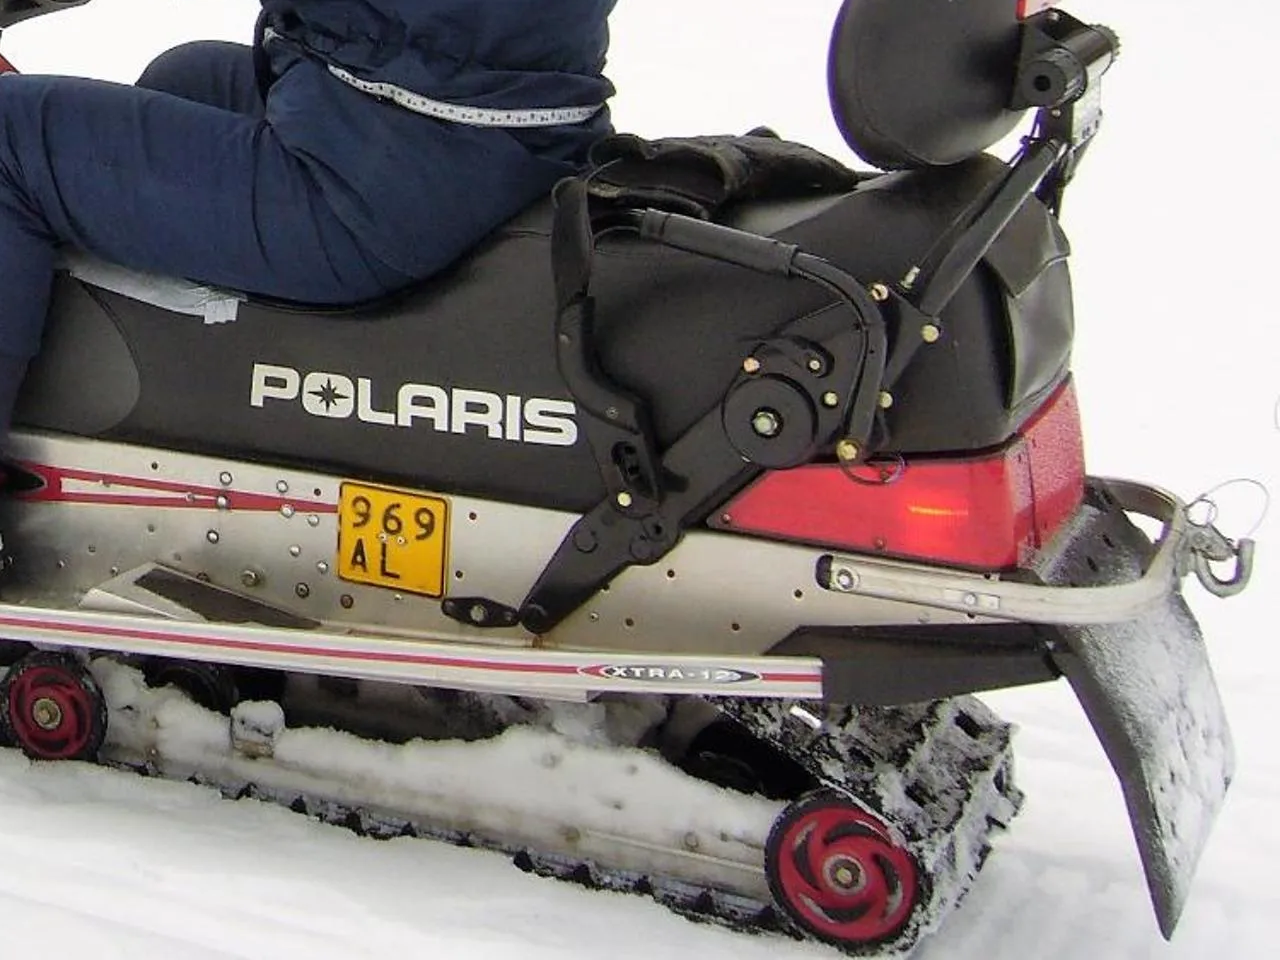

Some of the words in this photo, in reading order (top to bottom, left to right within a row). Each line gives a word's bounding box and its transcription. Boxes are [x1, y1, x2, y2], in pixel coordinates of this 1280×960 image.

[250, 363, 579, 447] POLARIS
[351, 496, 436, 540] 969
[350, 538, 401, 580] AL
